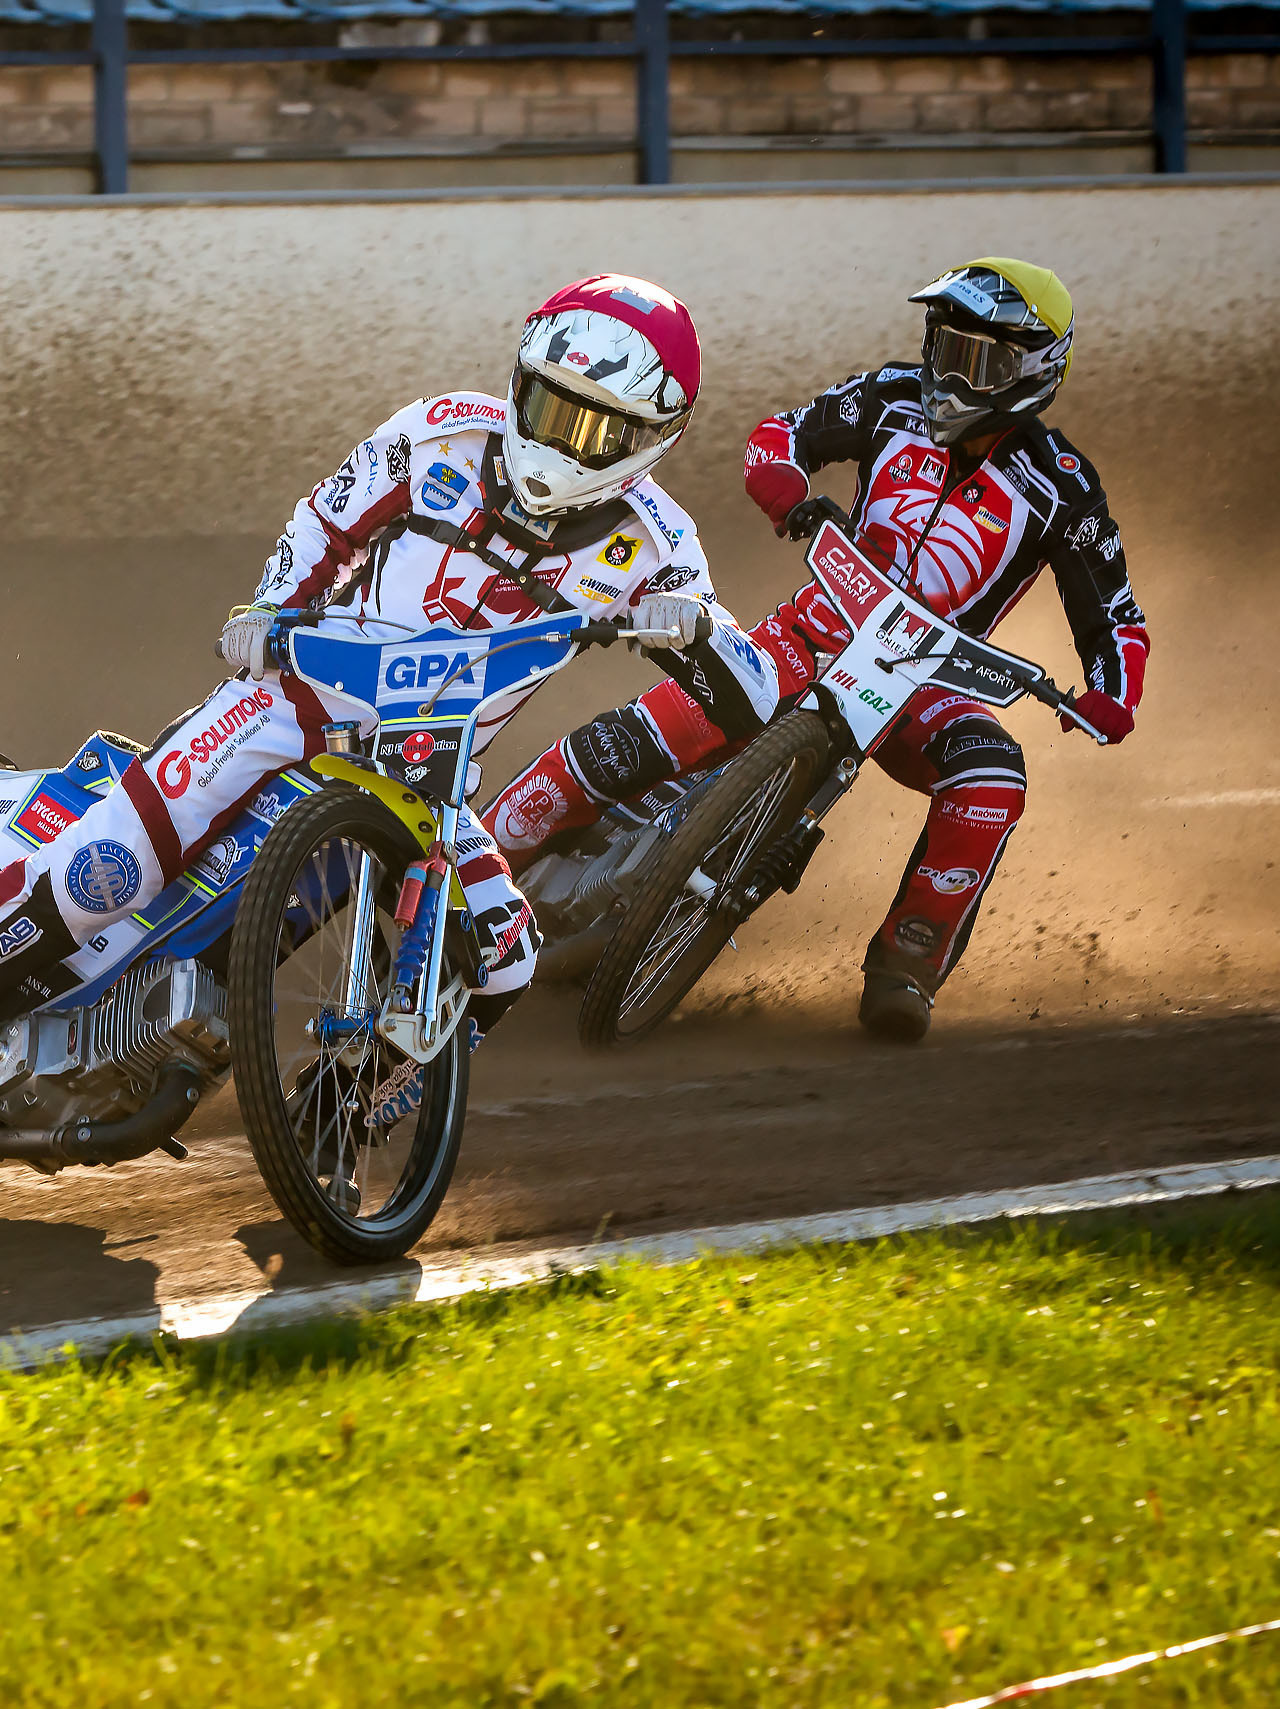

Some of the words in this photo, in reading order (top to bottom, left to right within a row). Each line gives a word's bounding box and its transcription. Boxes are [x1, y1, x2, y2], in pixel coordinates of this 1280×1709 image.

[426, 398, 506, 425] G-SOLUTION
[818, 556, 860, 599] GWARANT
[384, 652, 476, 690] GPA
[777, 639, 809, 680] AFORTI
[976, 665, 1016, 690] AFORTI
[830, 669, 894, 716] HIL-GAZ
[156, 687, 274, 800] G-SOLUTIONS
[197, 762, 220, 788] Global
[214, 743, 237, 768] Freight
[233, 723, 262, 746] Solutions
[260, 714, 271, 727] AB
[30, 799, 68, 832] BYGGSM
